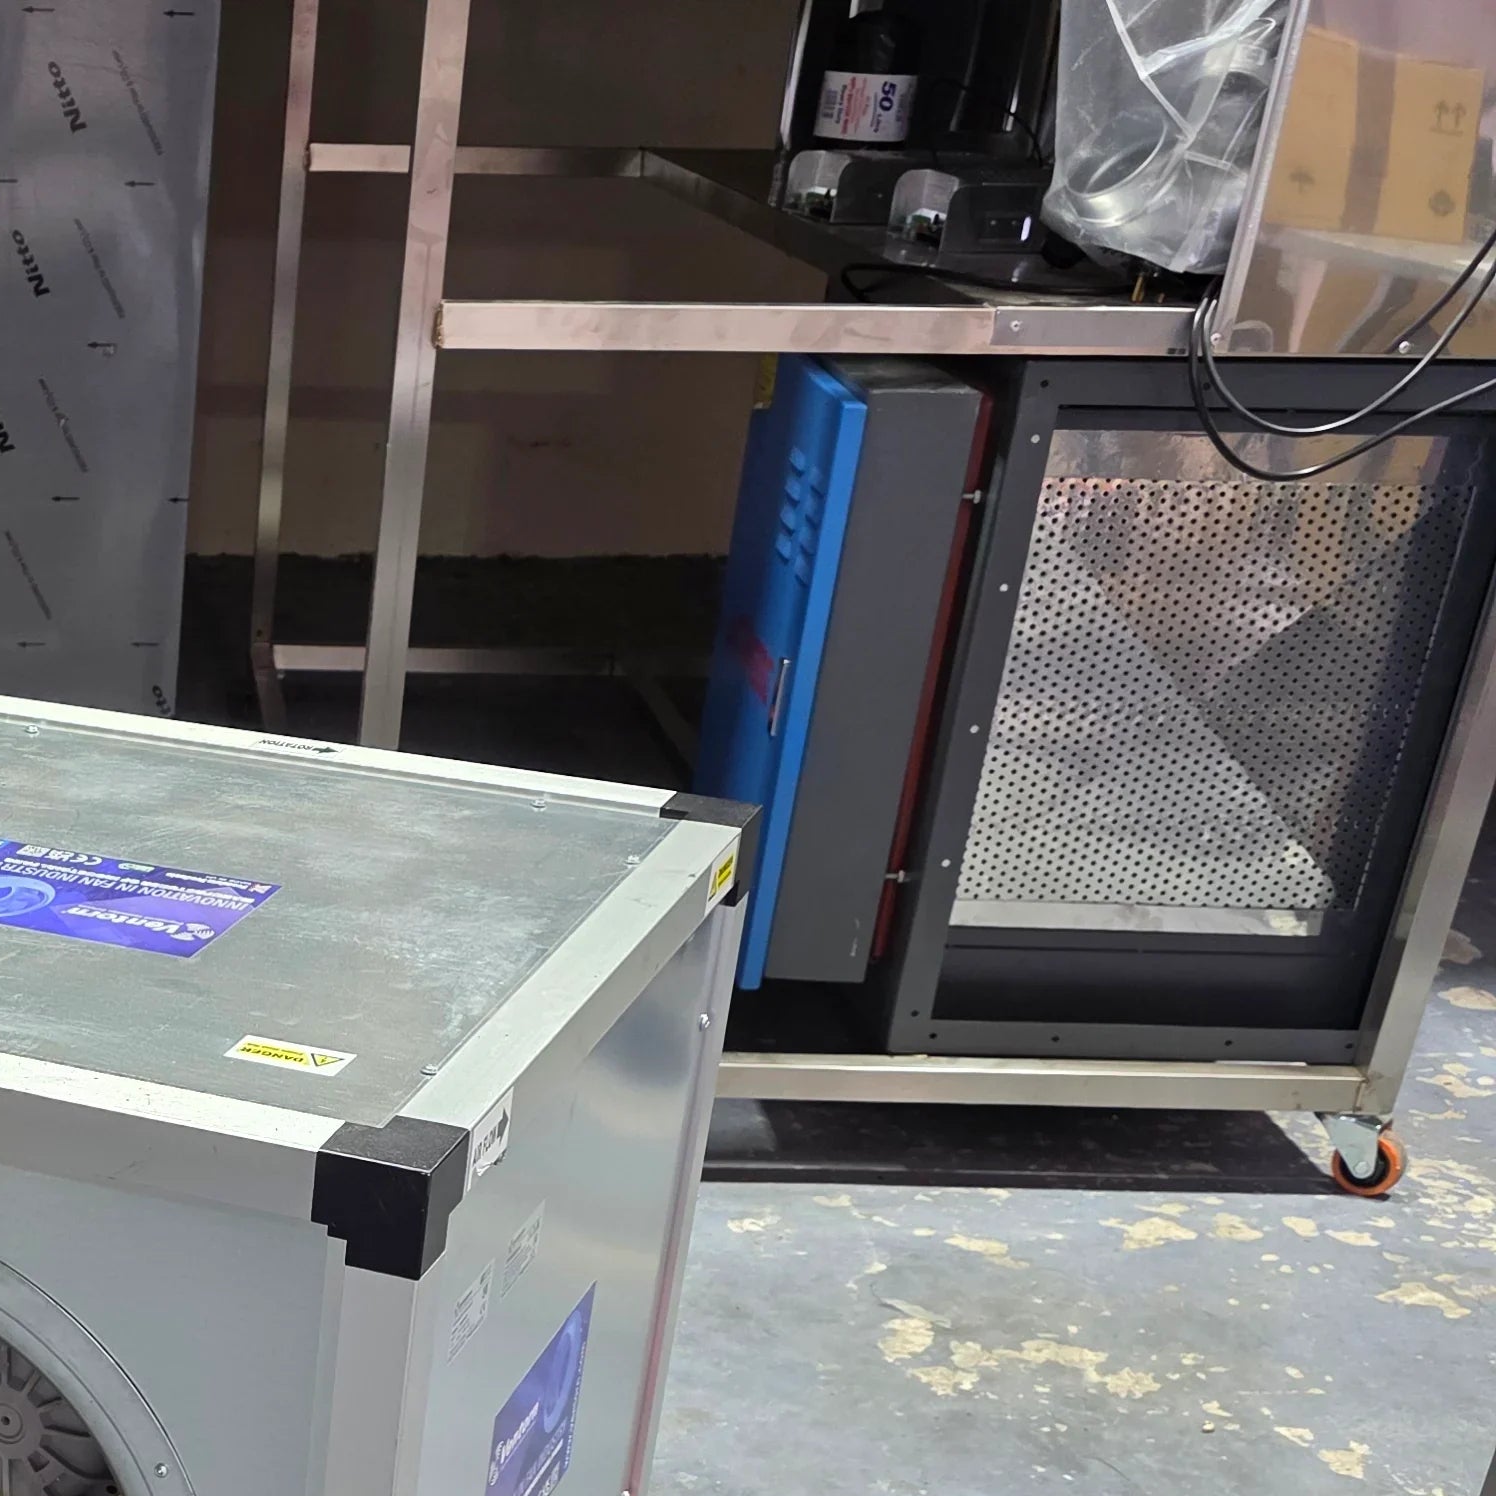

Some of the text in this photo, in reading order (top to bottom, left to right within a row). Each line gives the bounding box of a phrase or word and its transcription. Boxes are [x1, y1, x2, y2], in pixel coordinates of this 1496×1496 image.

[50, 63, 86, 133] Nitto
[878, 81, 898, 111] 50
[14, 231, 50, 296] Nitto
[259, 739, 314, 750] ROTATION
[77, 877, 117, 889] FAN
[115, 883, 139, 893] IN
[138, 886, 250, 911] INNOVATION
[240, 1046, 305, 1063] DANGER
